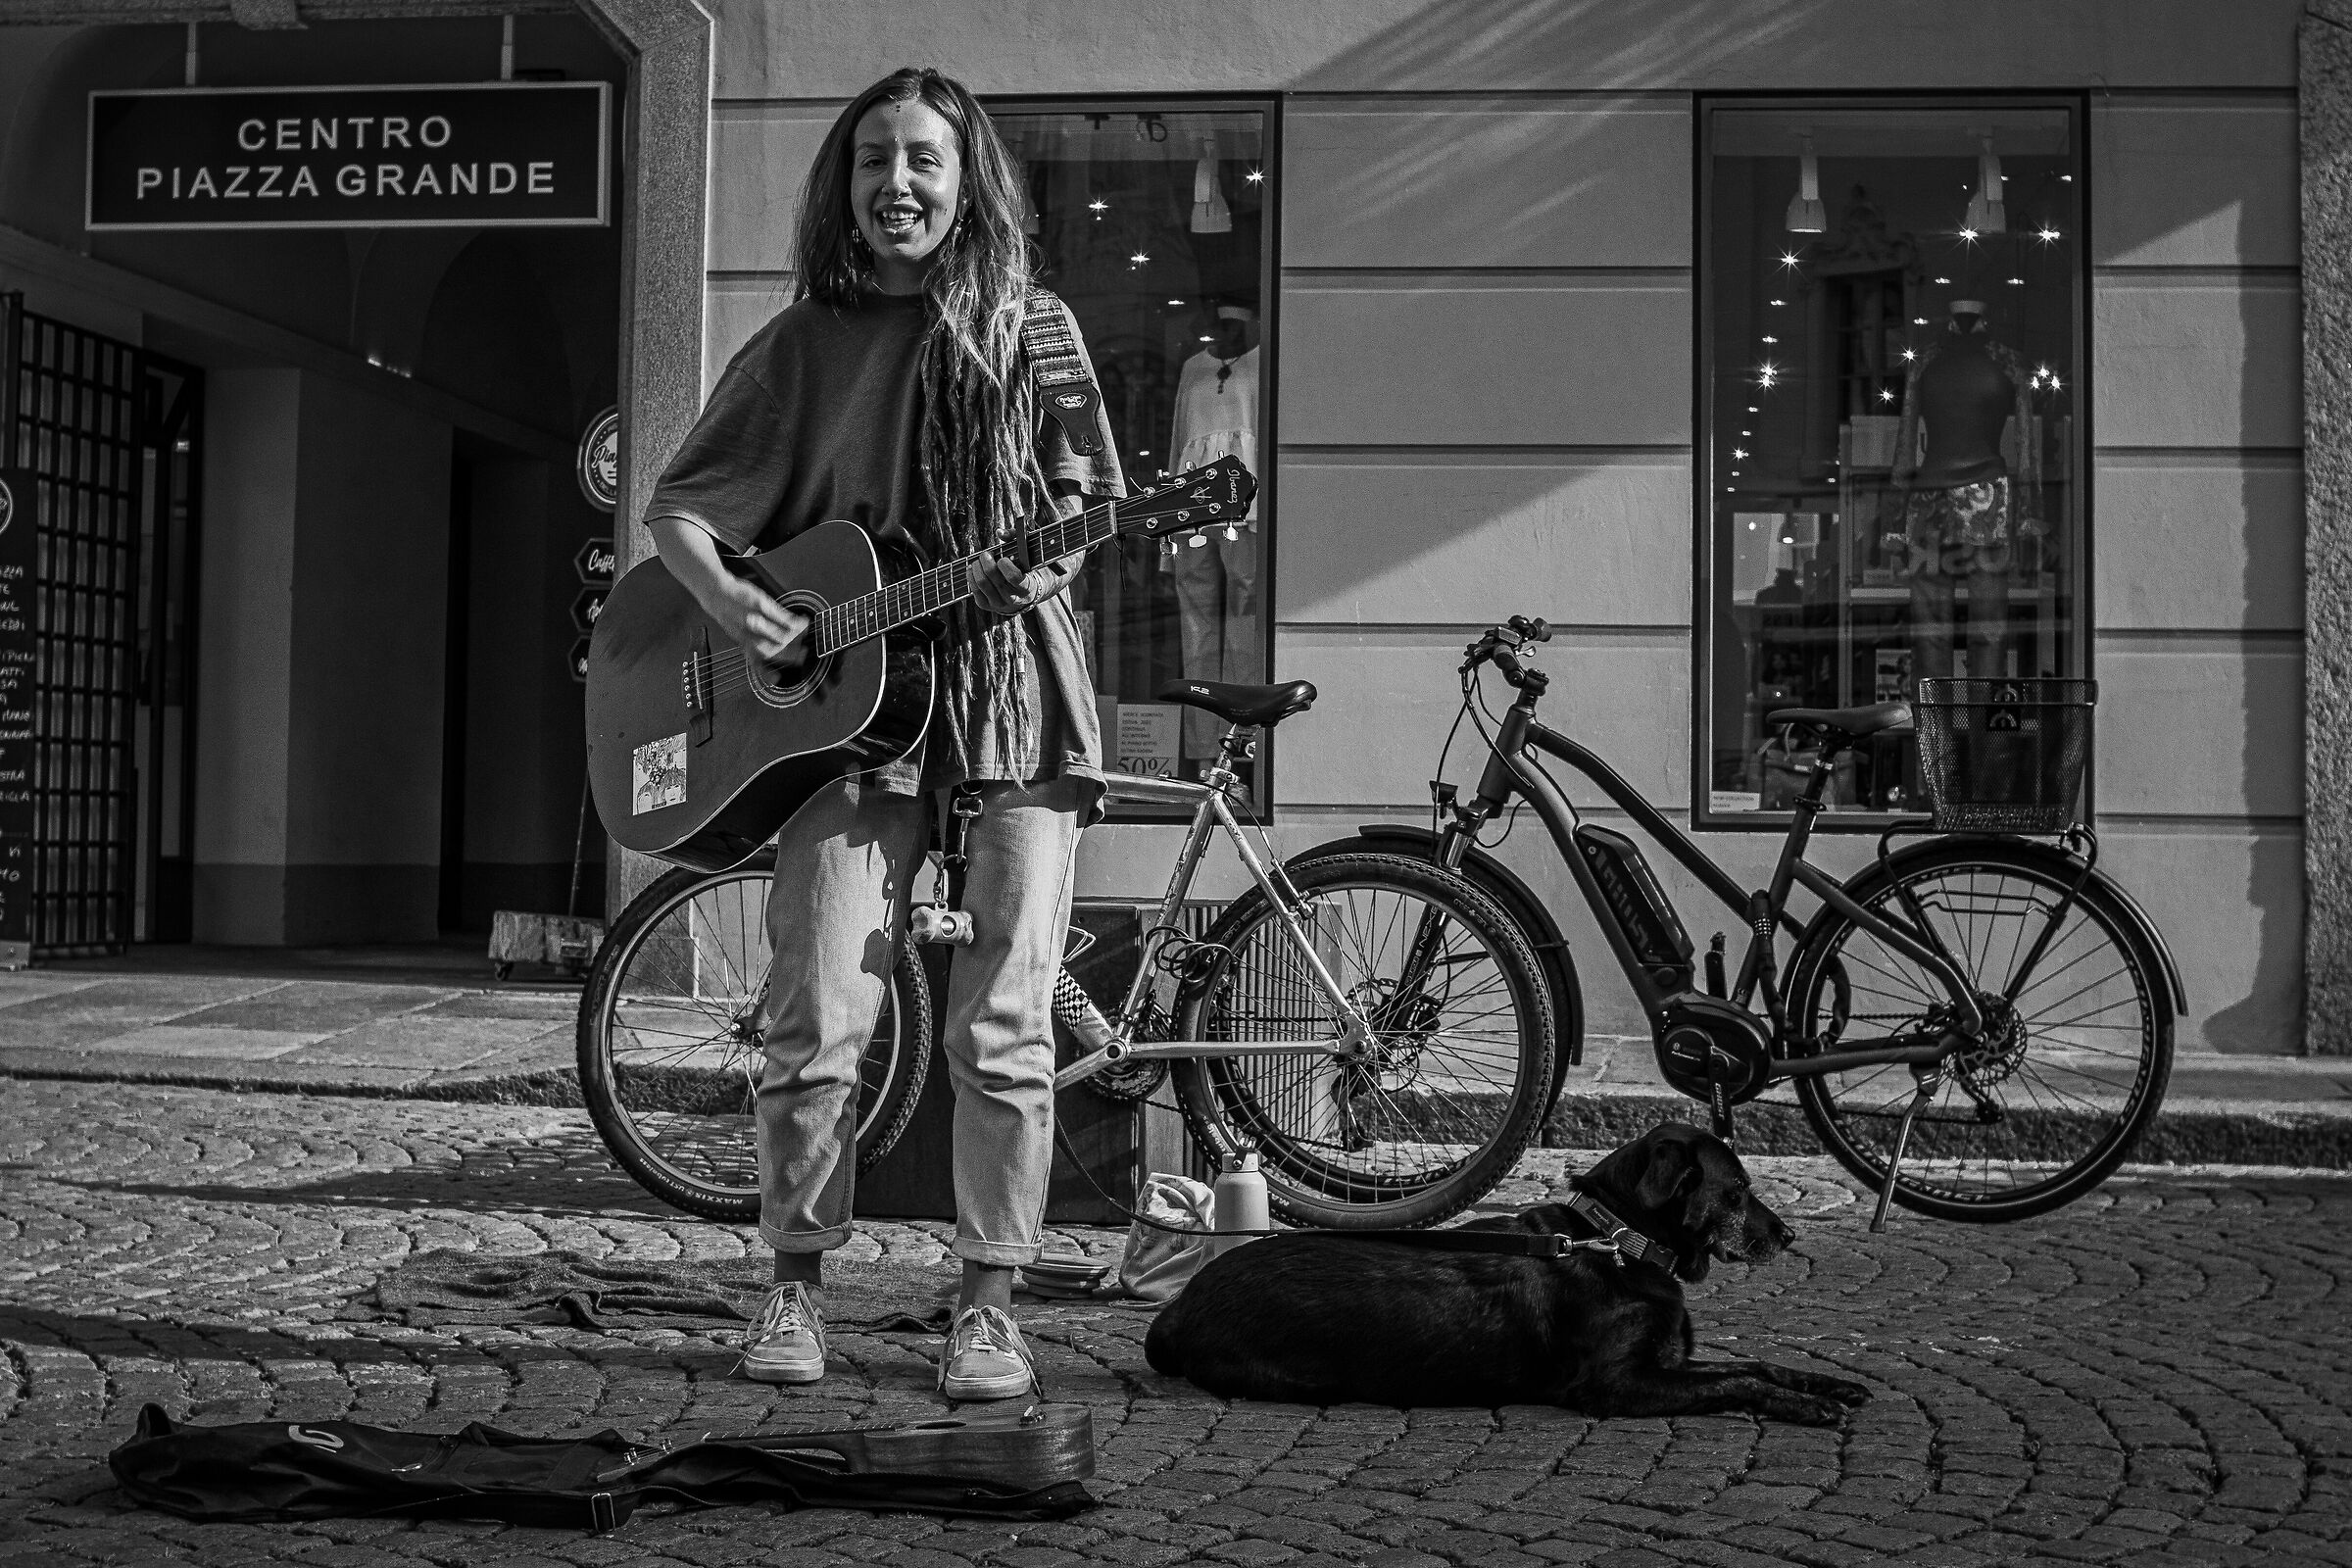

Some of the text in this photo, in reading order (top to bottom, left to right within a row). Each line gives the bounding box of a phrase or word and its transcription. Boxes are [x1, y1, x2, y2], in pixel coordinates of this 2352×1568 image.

[237, 116, 452, 152] CENTRO
[136, 161, 556, 199] PIAZZA GRANDE
[591, 443, 618, 468] Pia
[1227, 468, 1240, 505] Ibanez
[1190, 685, 1210, 695] K2
[695, 1191, 744, 1205] MAXXIS
[1268, 1190, 1291, 1207] MA
